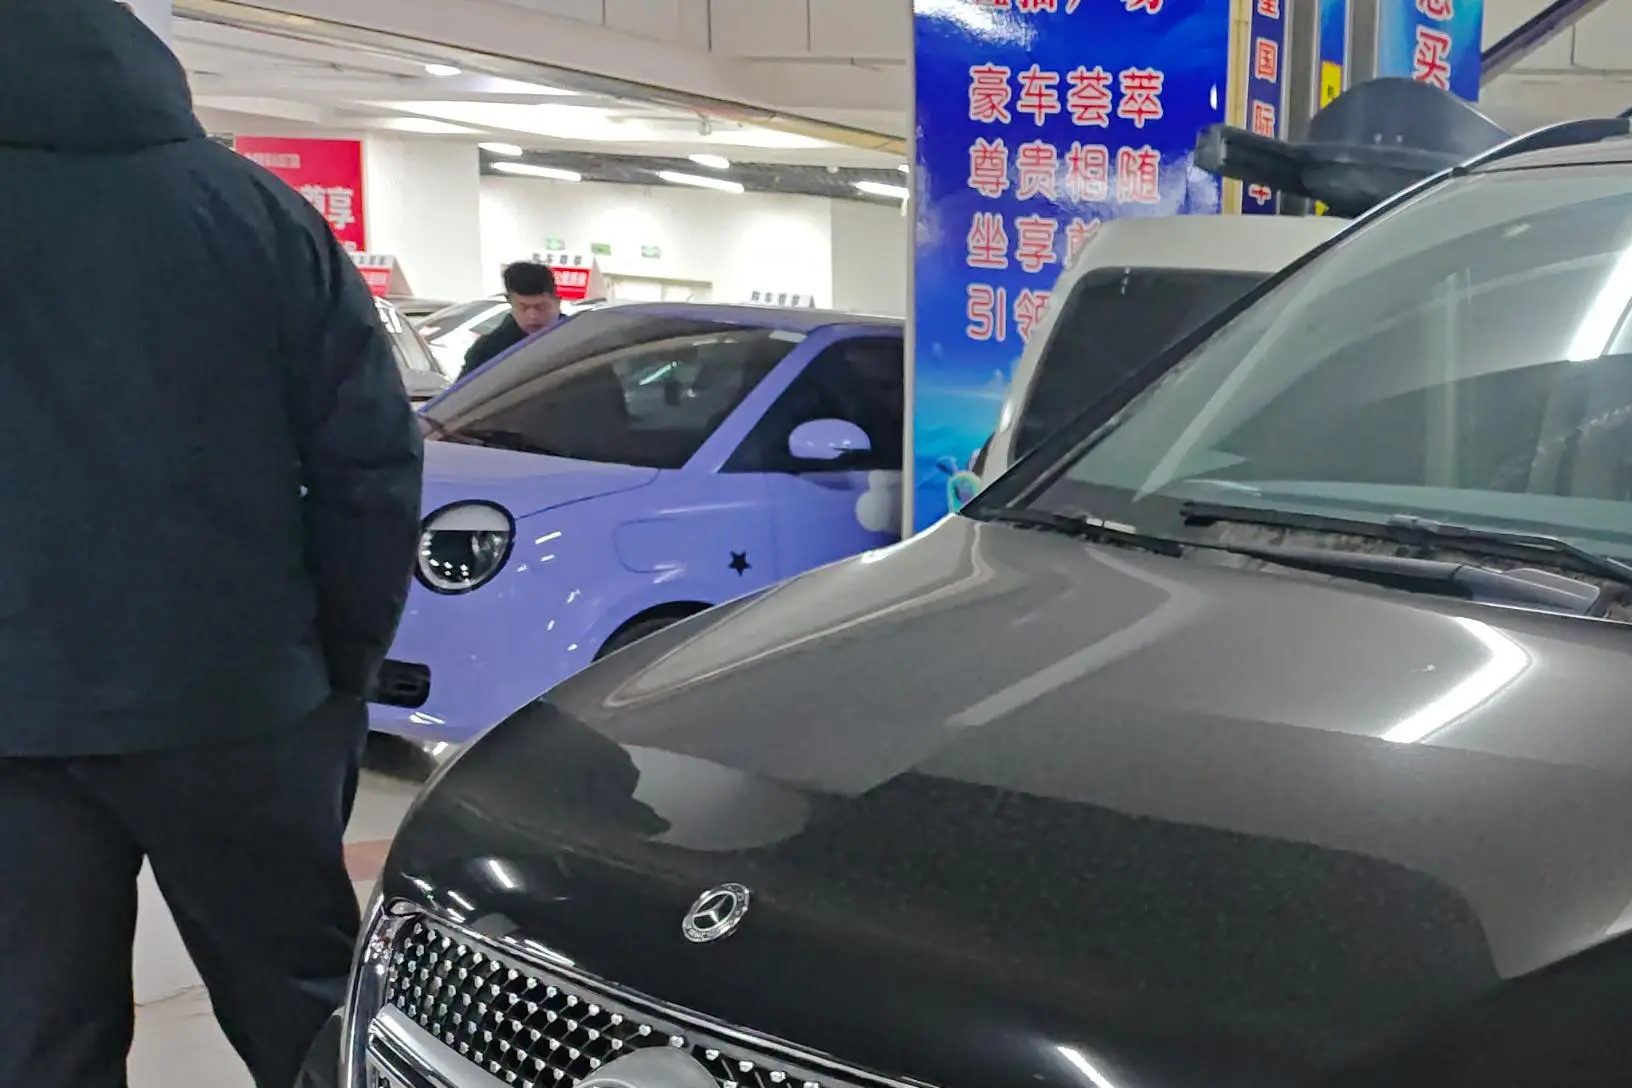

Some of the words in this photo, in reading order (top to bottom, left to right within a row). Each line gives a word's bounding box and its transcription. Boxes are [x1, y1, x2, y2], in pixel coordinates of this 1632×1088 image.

[968, 63, 1164, 128] 豪车荟萃
[968, 138, 1160, 203] 尊贵相随
